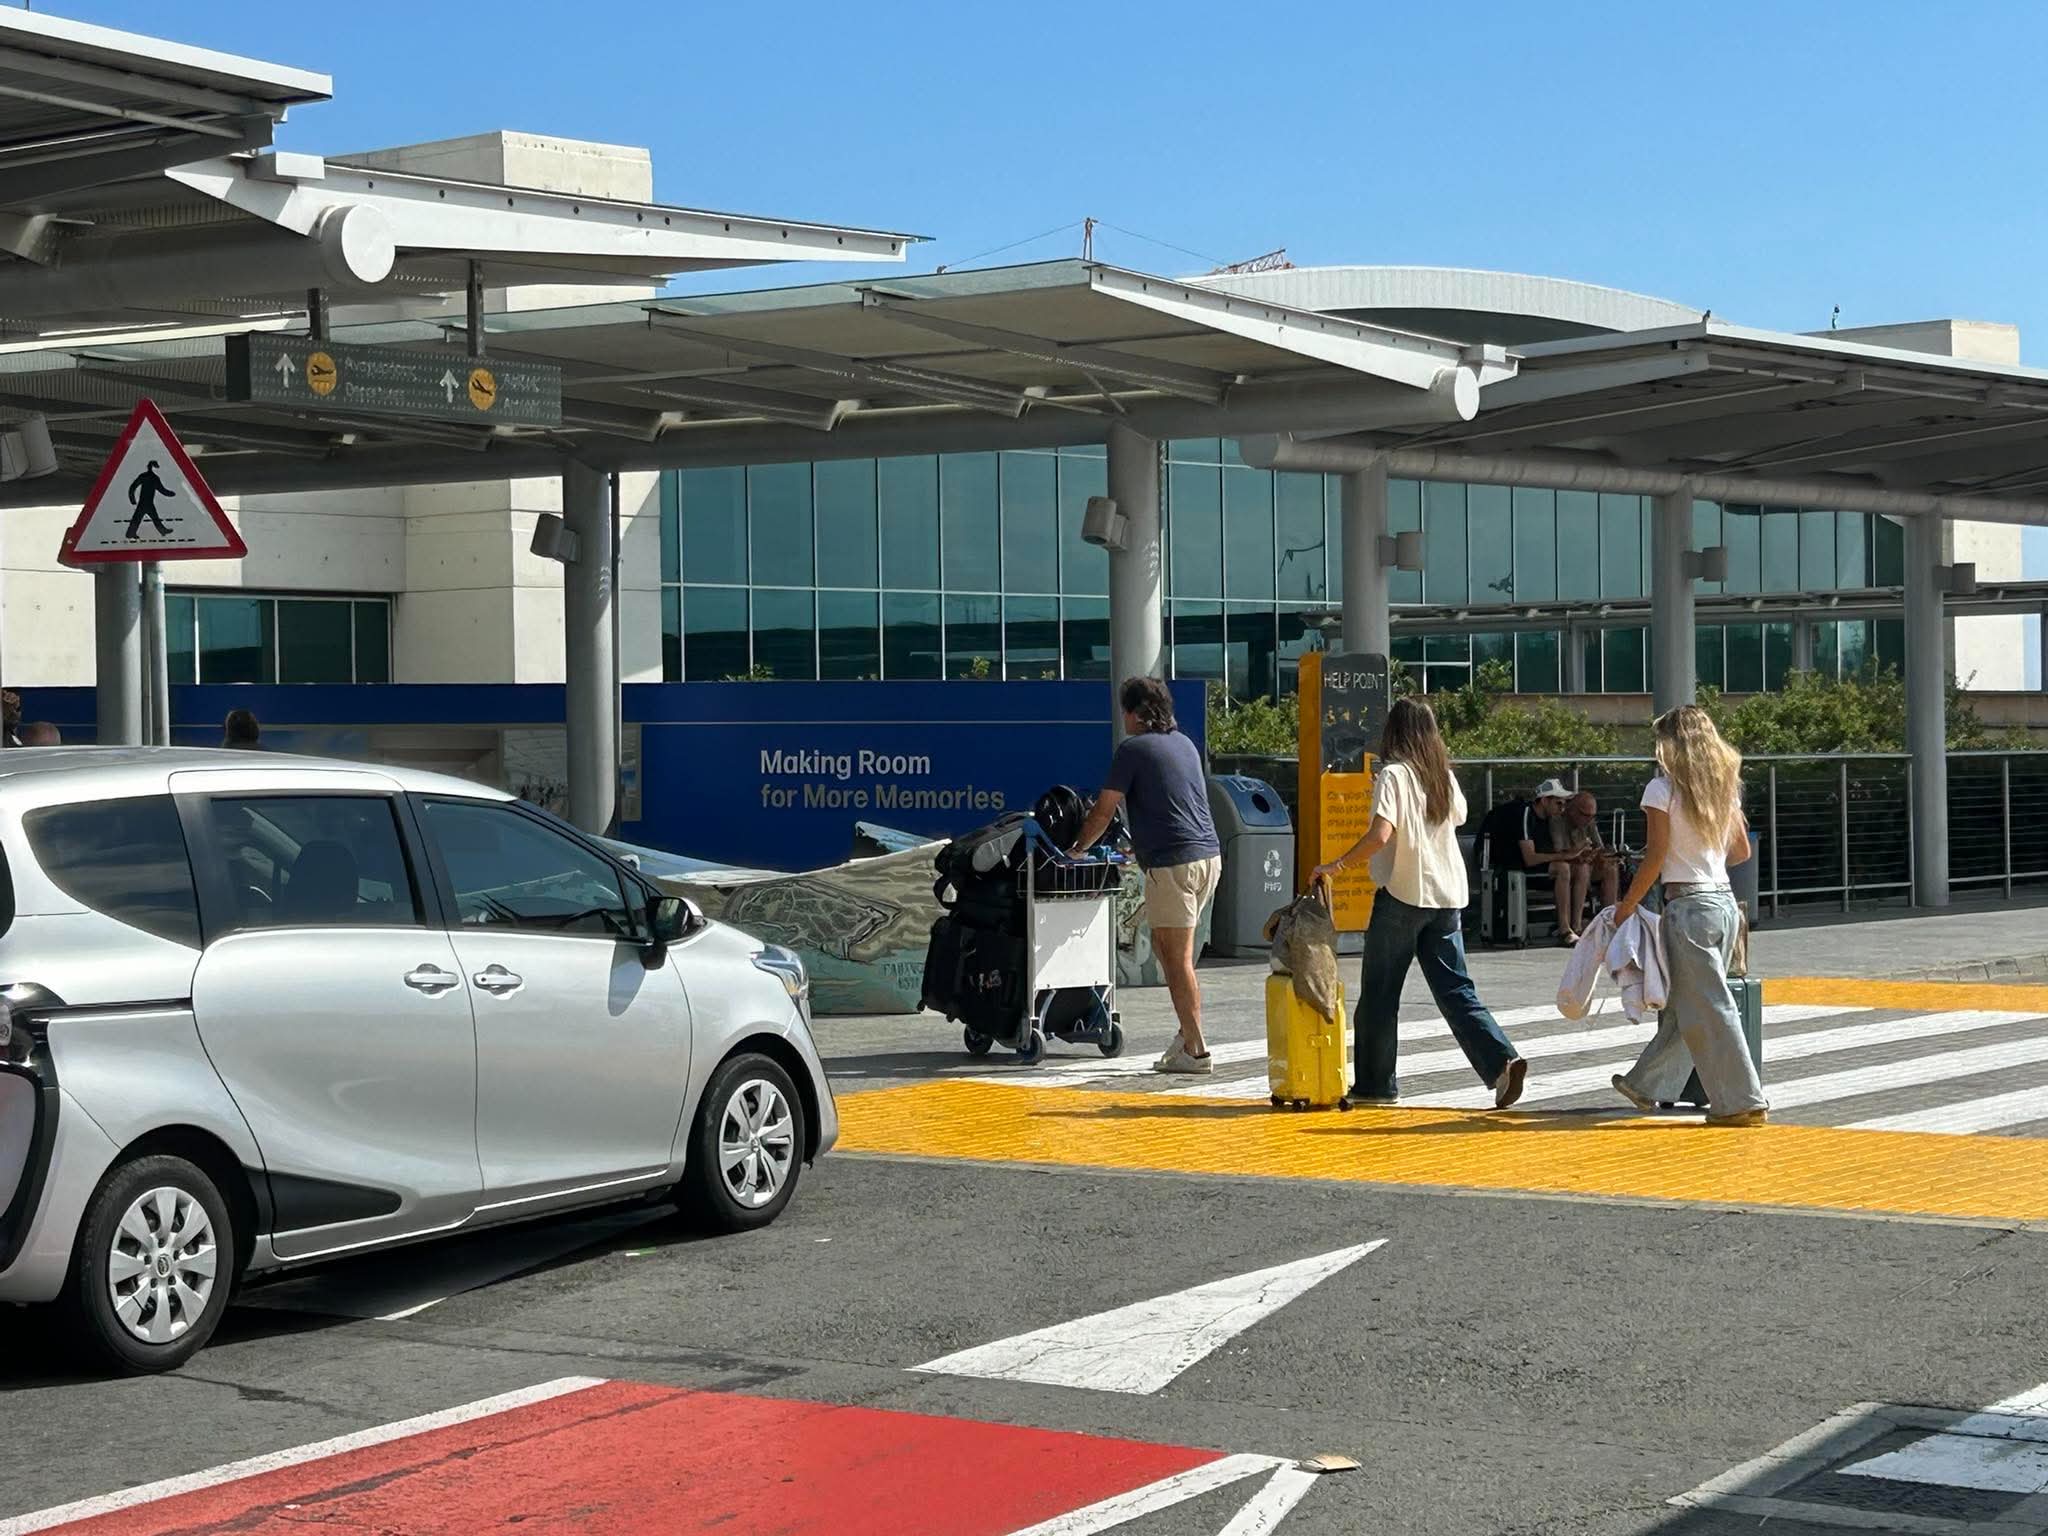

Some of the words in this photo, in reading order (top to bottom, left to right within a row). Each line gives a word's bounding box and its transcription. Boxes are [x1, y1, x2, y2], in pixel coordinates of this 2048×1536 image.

[1324, 671, 1351, 690] HELP
[1353, 672, 1385, 690] POINT
[760, 750, 852, 780] Making
[858, 750, 931, 774] Room
[761, 783, 798, 808] for
[803, 784, 869, 809] More
[875, 784, 1006, 810] Memories
